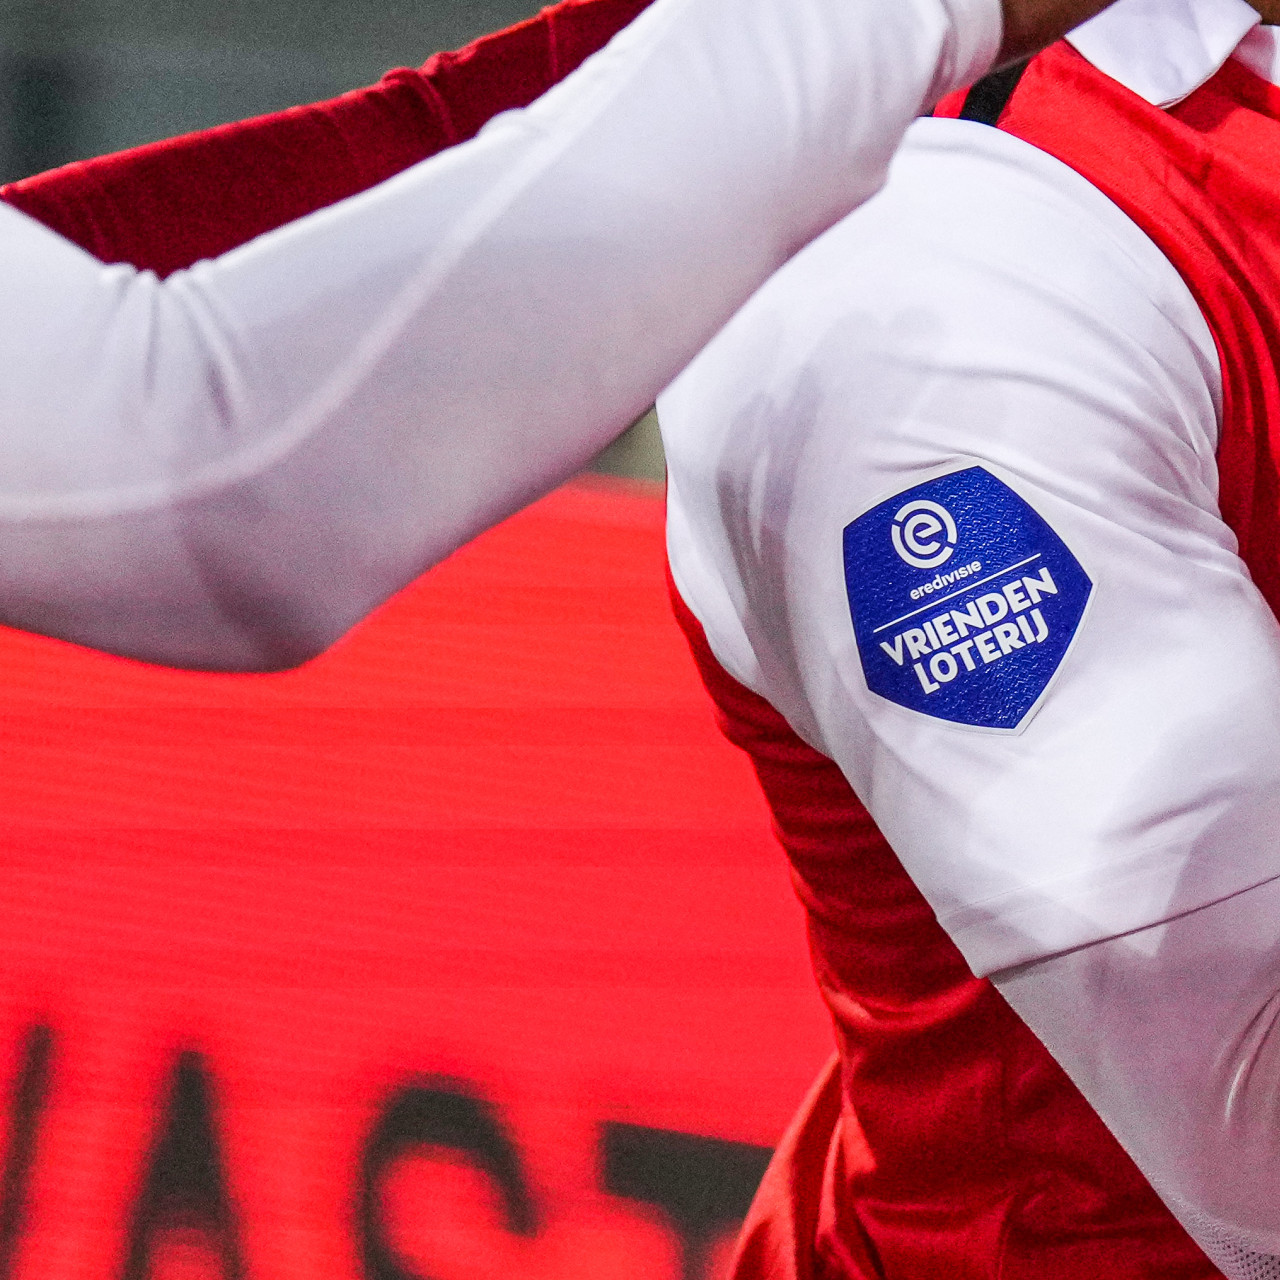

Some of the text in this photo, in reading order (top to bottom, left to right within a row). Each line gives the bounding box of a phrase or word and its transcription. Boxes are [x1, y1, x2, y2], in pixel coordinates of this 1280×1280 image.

[879, 566, 1058, 666] VRIENDEN
[909, 560, 982, 600] eredivisie
[913, 609, 1049, 694] LOTERIJ
